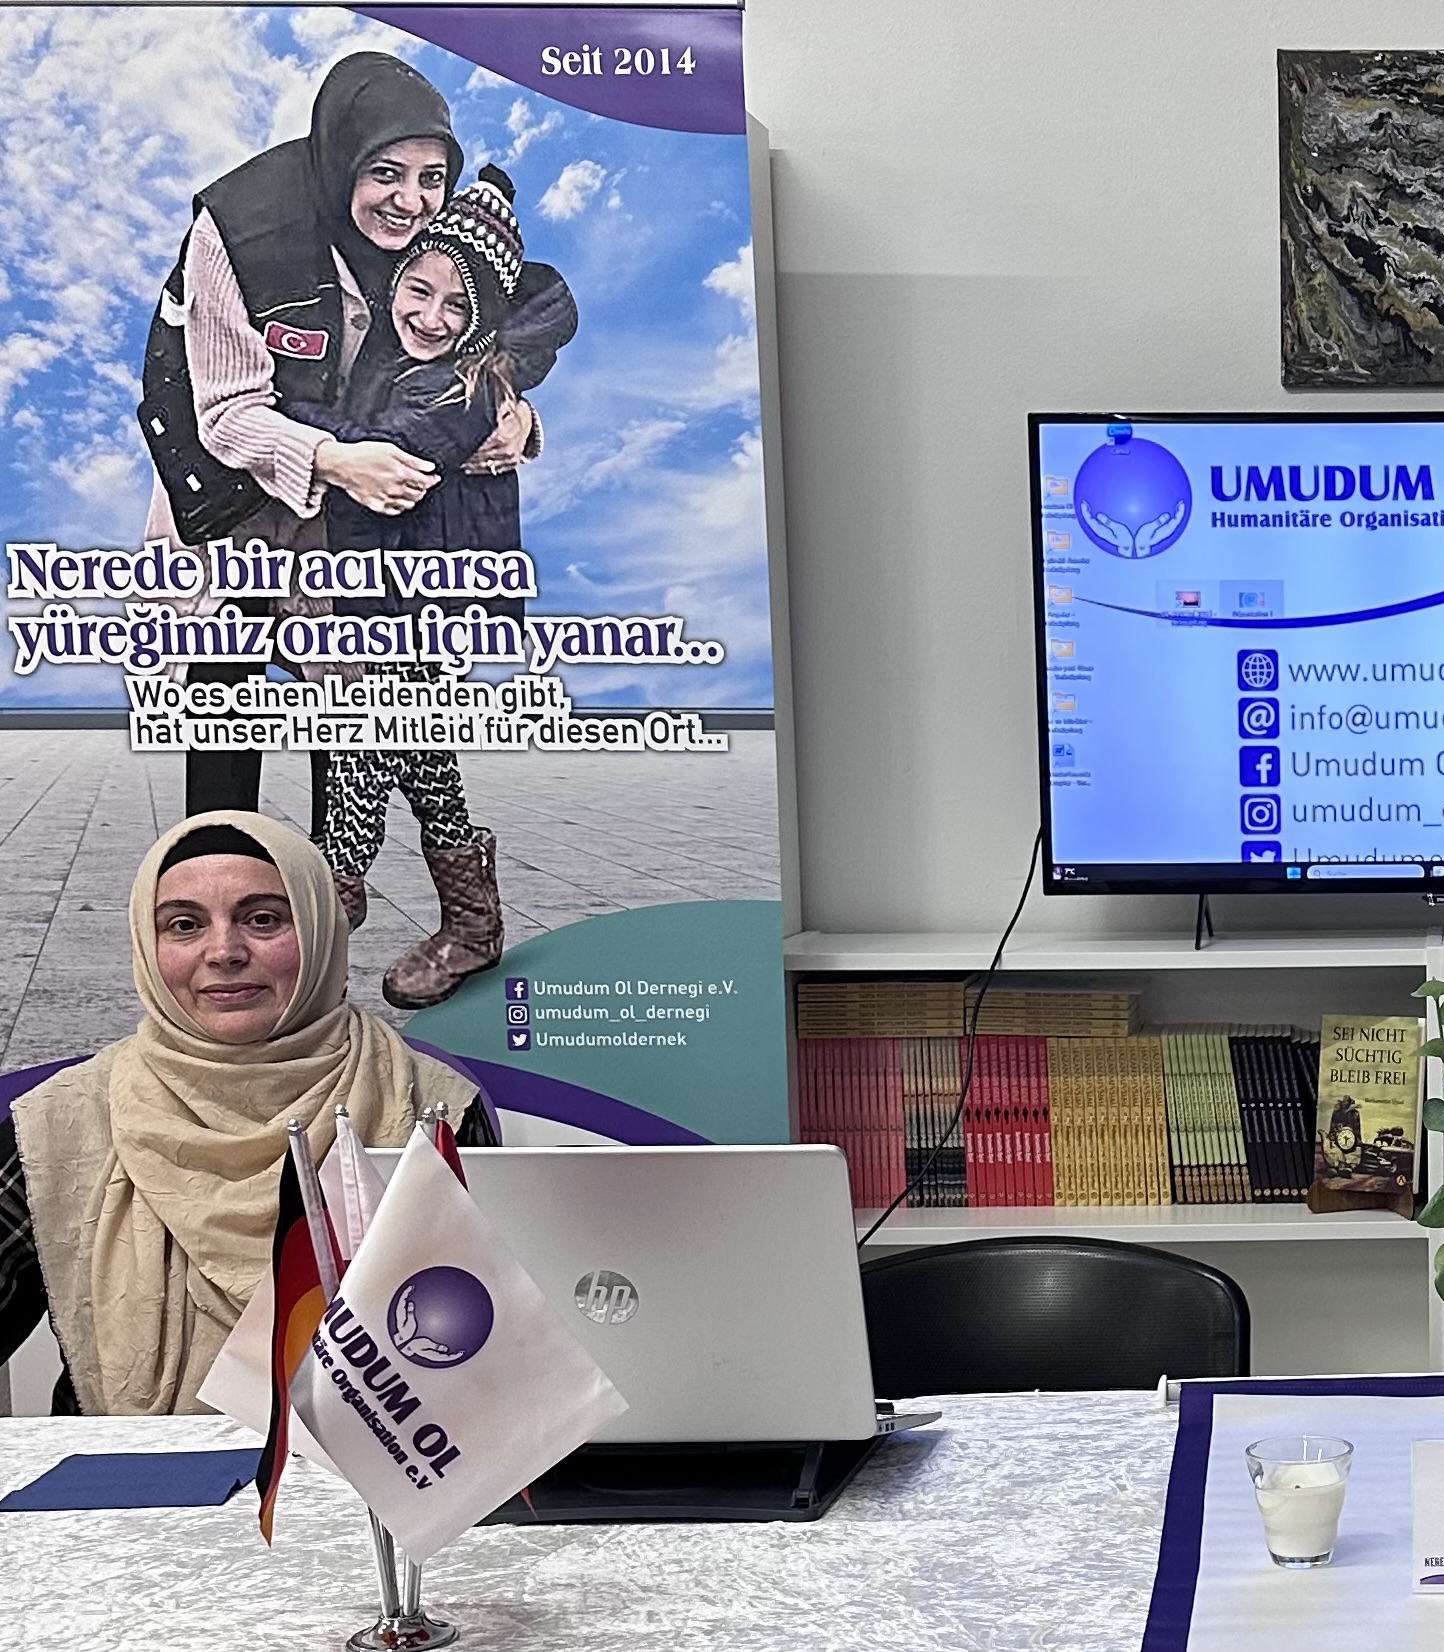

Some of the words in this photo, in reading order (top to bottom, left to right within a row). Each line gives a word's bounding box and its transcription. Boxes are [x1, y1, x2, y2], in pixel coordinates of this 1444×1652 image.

[541, 46, 602, 75] Seit
[614, 46, 697, 75] 2014
[1210, 464, 1435, 501] UMUDUM
[1211, 509, 1331, 528] Humanitäre
[14, 545, 197, 591] Nerede
[216, 541, 287, 591] bir
[304, 552, 380, 591] acı
[391, 553, 531, 591] varsa
[14, 606, 267, 669] yüreğimiz
[282, 616, 409, 657] orası
[426, 609, 518, 668] için
[530, 618, 718, 665] yanar...
[133, 681, 179, 708] Wo
[191, 685, 225, 708] es
[236, 681, 319, 708] einen
[331, 680, 489, 708] Leidenden
[502, 680, 565, 712] gibt,
[136, 716, 183, 744] hat
[194, 721, 281, 744] unser
[293, 716, 363, 744] Herz
[375, 715, 474, 744] Mitleid
[485, 716, 528, 744] für
[540, 716, 638, 744] diesen
[650, 716, 723, 744] Ort...
[1291, 751, 1424, 777] Umudum
[534, 980, 609, 995] Umudum
[615, 980, 632, 995] Ol
[637, 980, 703, 998] Dernegi
[707, 980, 739, 995] e.V.
[535, 1004, 710, 1022] umudum_ol_dernegi
[536, 1031, 687, 1046] Umudumoldernek
[1333, 1027, 1355, 1041] SEI
[1359, 1028, 1407, 1043] NICHT
[1336, 1046, 1402, 1064] SÜCHTIG
[1330, 1069, 1370, 1084] BLEIB
[1375, 1070, 1406, 1085] FREI
[585, 1270, 632, 1324] hp
[331, 1368, 409, 1465] Organisation
[412, 1423, 461, 1479] OL
